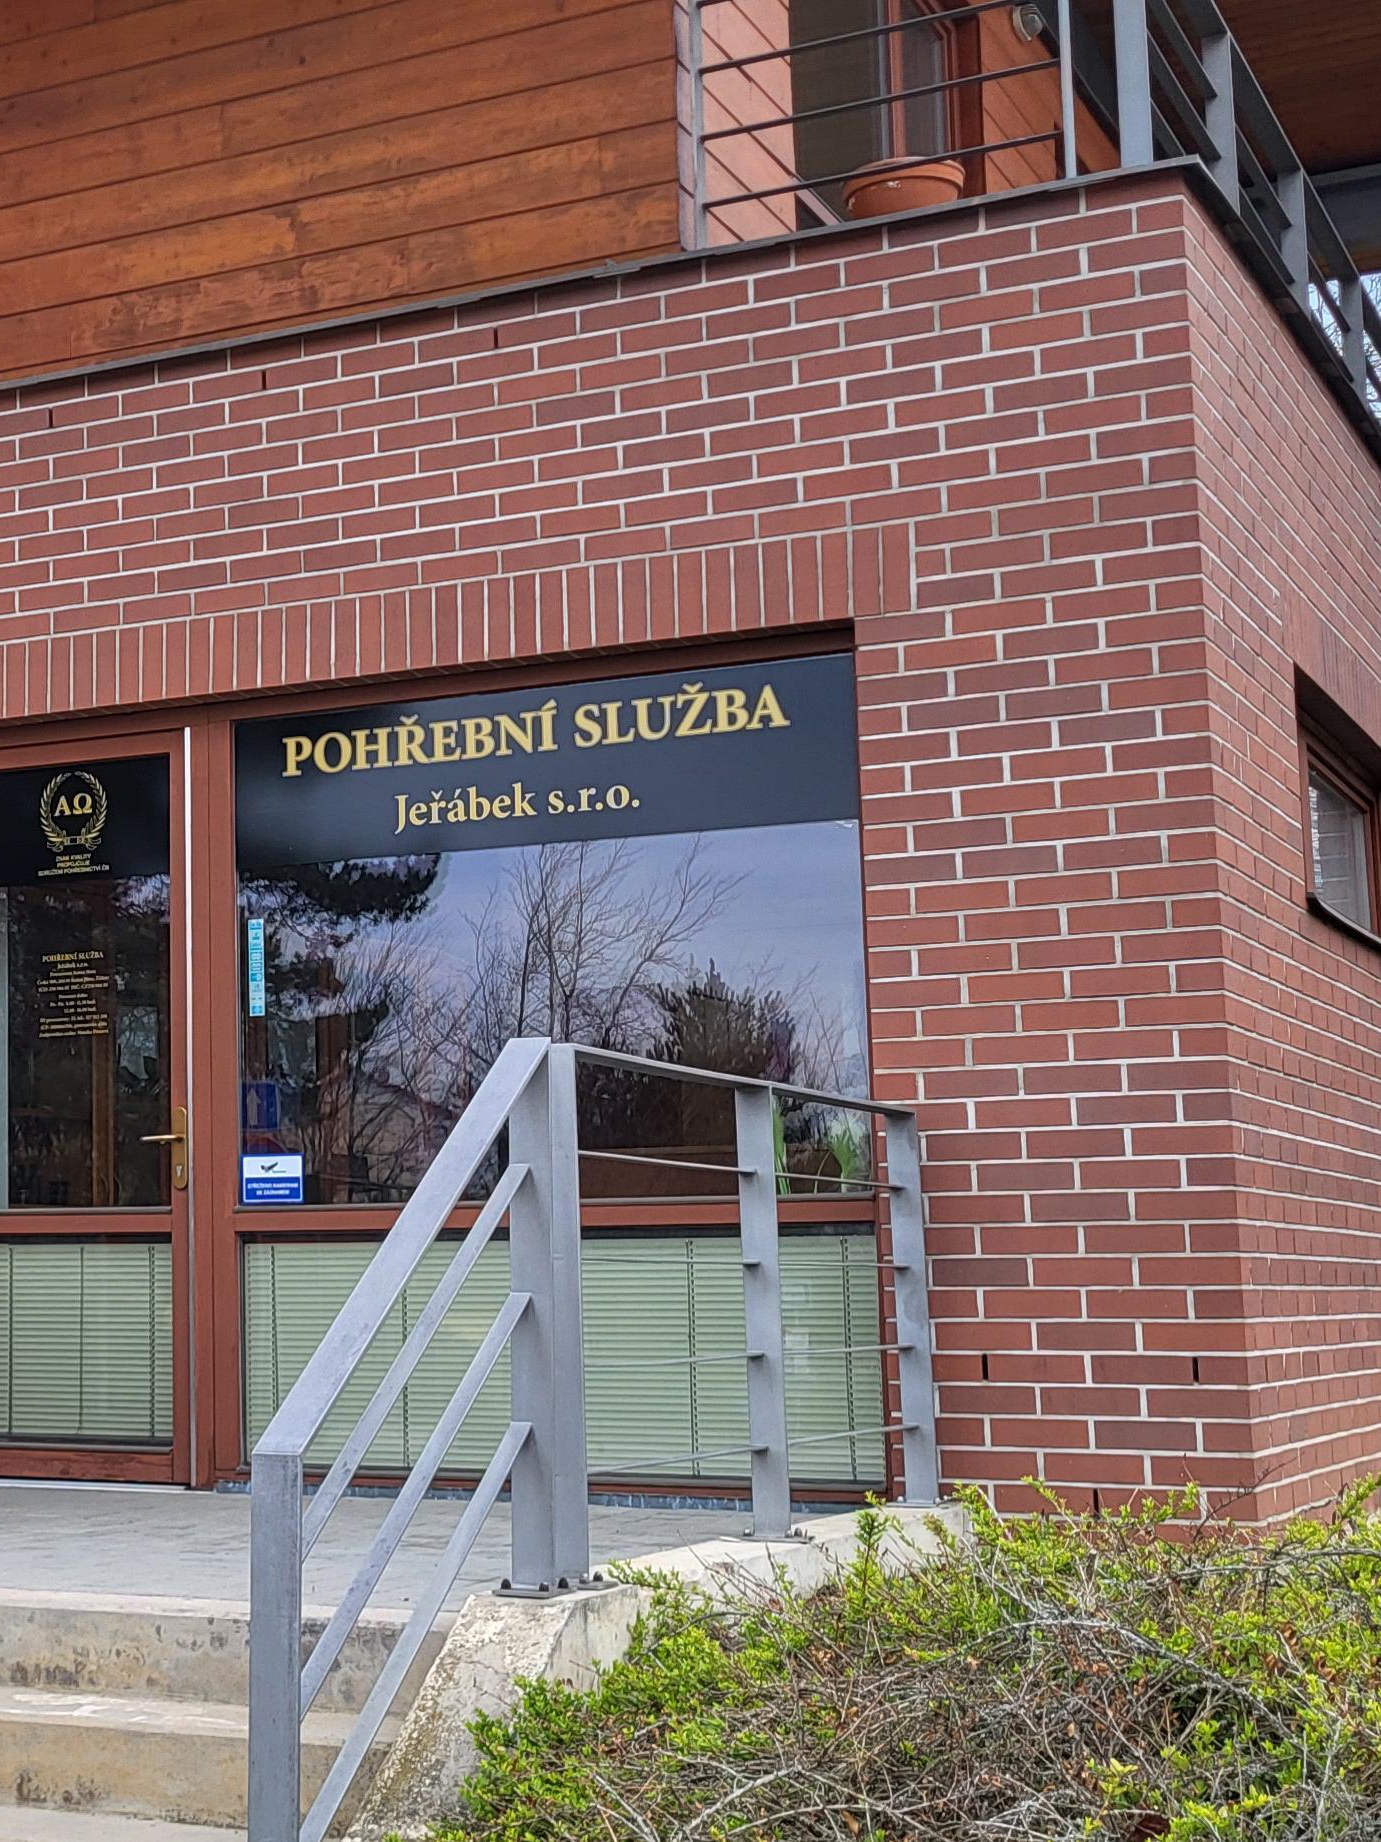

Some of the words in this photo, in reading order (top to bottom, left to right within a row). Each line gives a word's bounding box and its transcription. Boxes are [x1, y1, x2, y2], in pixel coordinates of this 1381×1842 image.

[282, 699, 559, 778] POHŘEBNÍ
[573, 681, 791, 748] SLUŽBA
[394, 781, 538, 835] Jeřábek
[547, 783, 641, 815] s.r.o.
